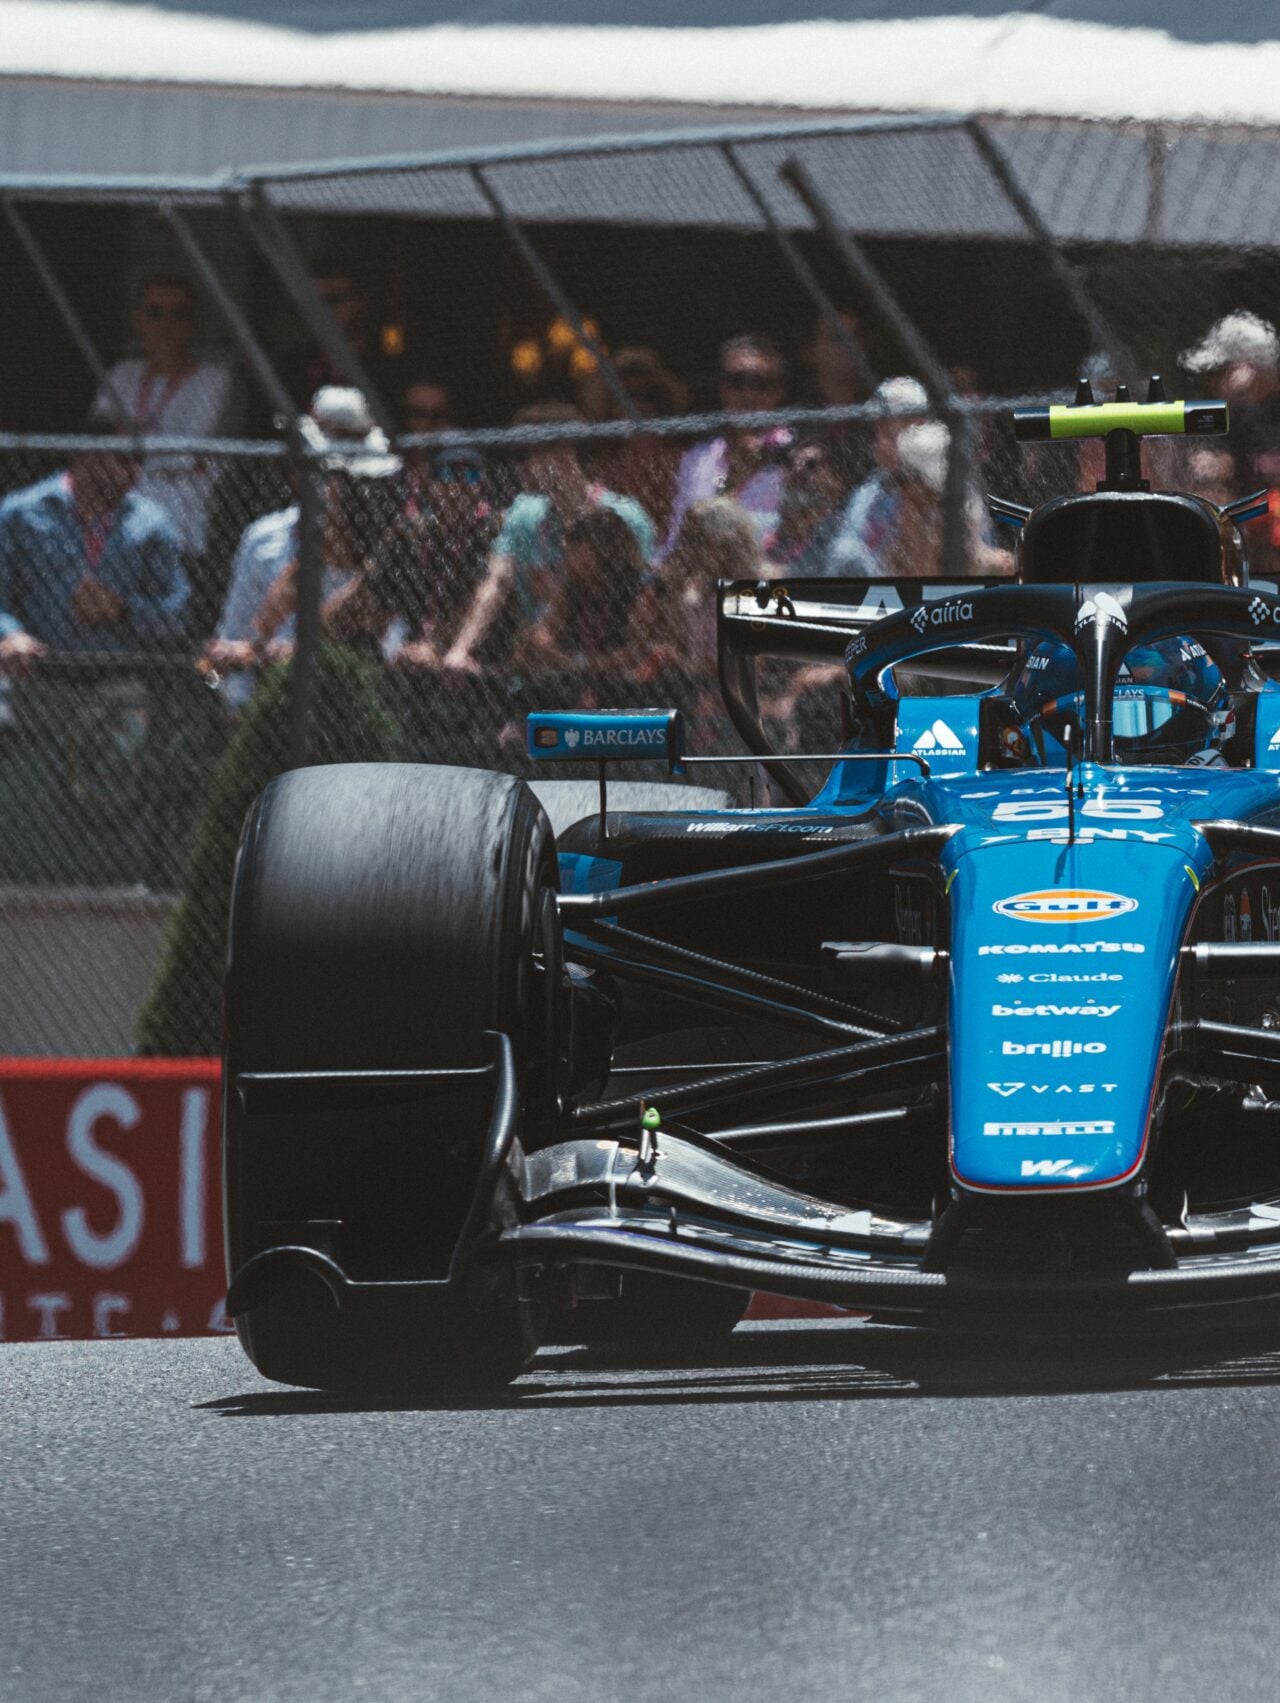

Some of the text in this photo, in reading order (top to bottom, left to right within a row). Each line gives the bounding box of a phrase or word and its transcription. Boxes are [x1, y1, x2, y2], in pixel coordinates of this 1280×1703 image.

[930, 600, 973, 625] airia
[583, 729, 666, 746] BARCLAYS
[911, 748, 966, 756] ATLASSIAN
[1010, 786, 1209, 796] BACLAYS
[992, 799, 1164, 821] 55
[686, 822, 834, 834] WilliamsF1.com
[1026, 827, 1176, 843] BNY
[1002, 898, 1126, 912] Gulf
[978, 941, 1145, 956] KOMATSU
[1028, 972, 1123, 984] Claude
[991, 1003, 1122, 1017] betway
[1002, 1040, 1107, 1058] brillio
[1031, 1083, 1118, 1094] VAST
[983, 1120, 1115, 1136] PIRELLI
